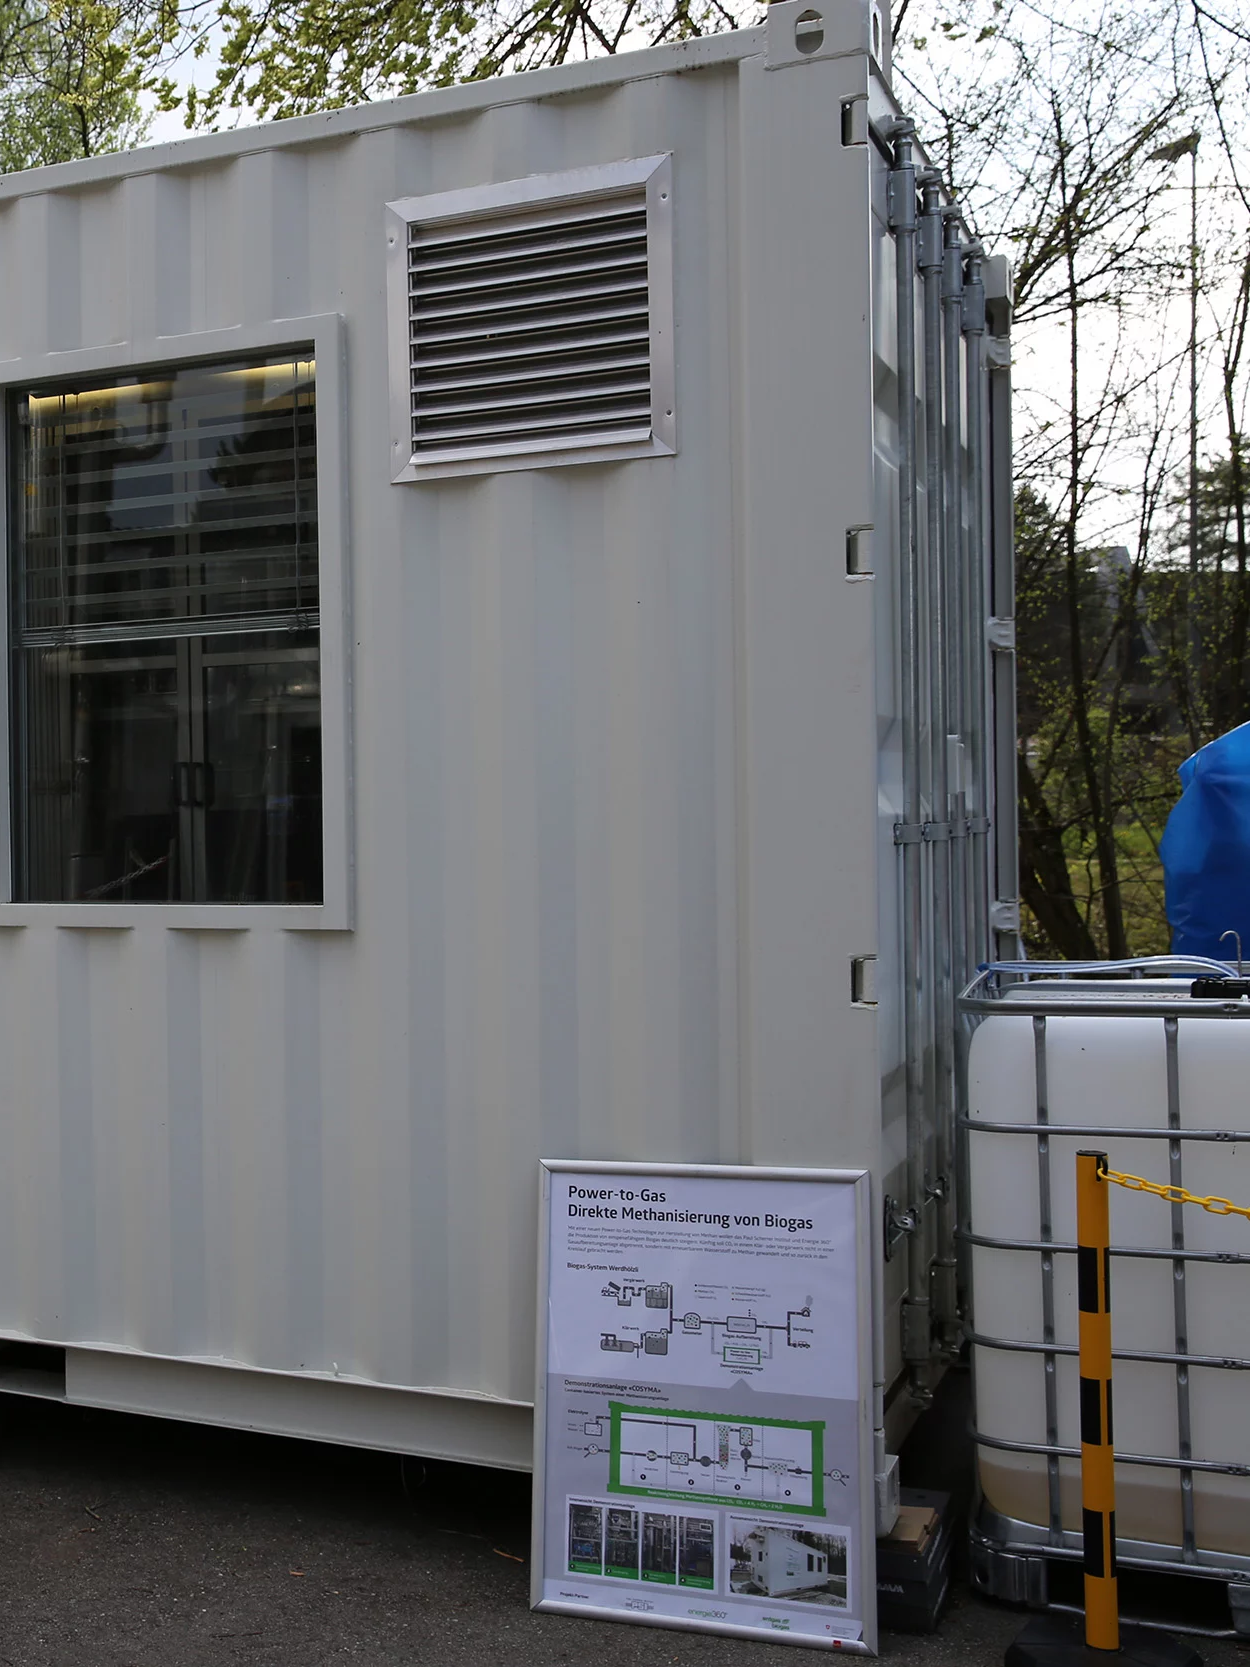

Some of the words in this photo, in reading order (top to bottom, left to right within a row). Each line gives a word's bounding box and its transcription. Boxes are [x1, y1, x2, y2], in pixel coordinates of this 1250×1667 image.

[568, 1185, 666, 1203] Power-to-Gas
[568, 1204, 618, 1220] Direkte
[621, 1207, 730, 1228] Methanisierung
[734, 1216, 760, 1226] von
[764, 1214, 814, 1232] Biogas
[608, 1264, 638, 1273] Werdhölzli
[564, 1380, 627, 1391] Demonstrationsanlage
[628, 1385, 661, 1393] «COSYMA»
